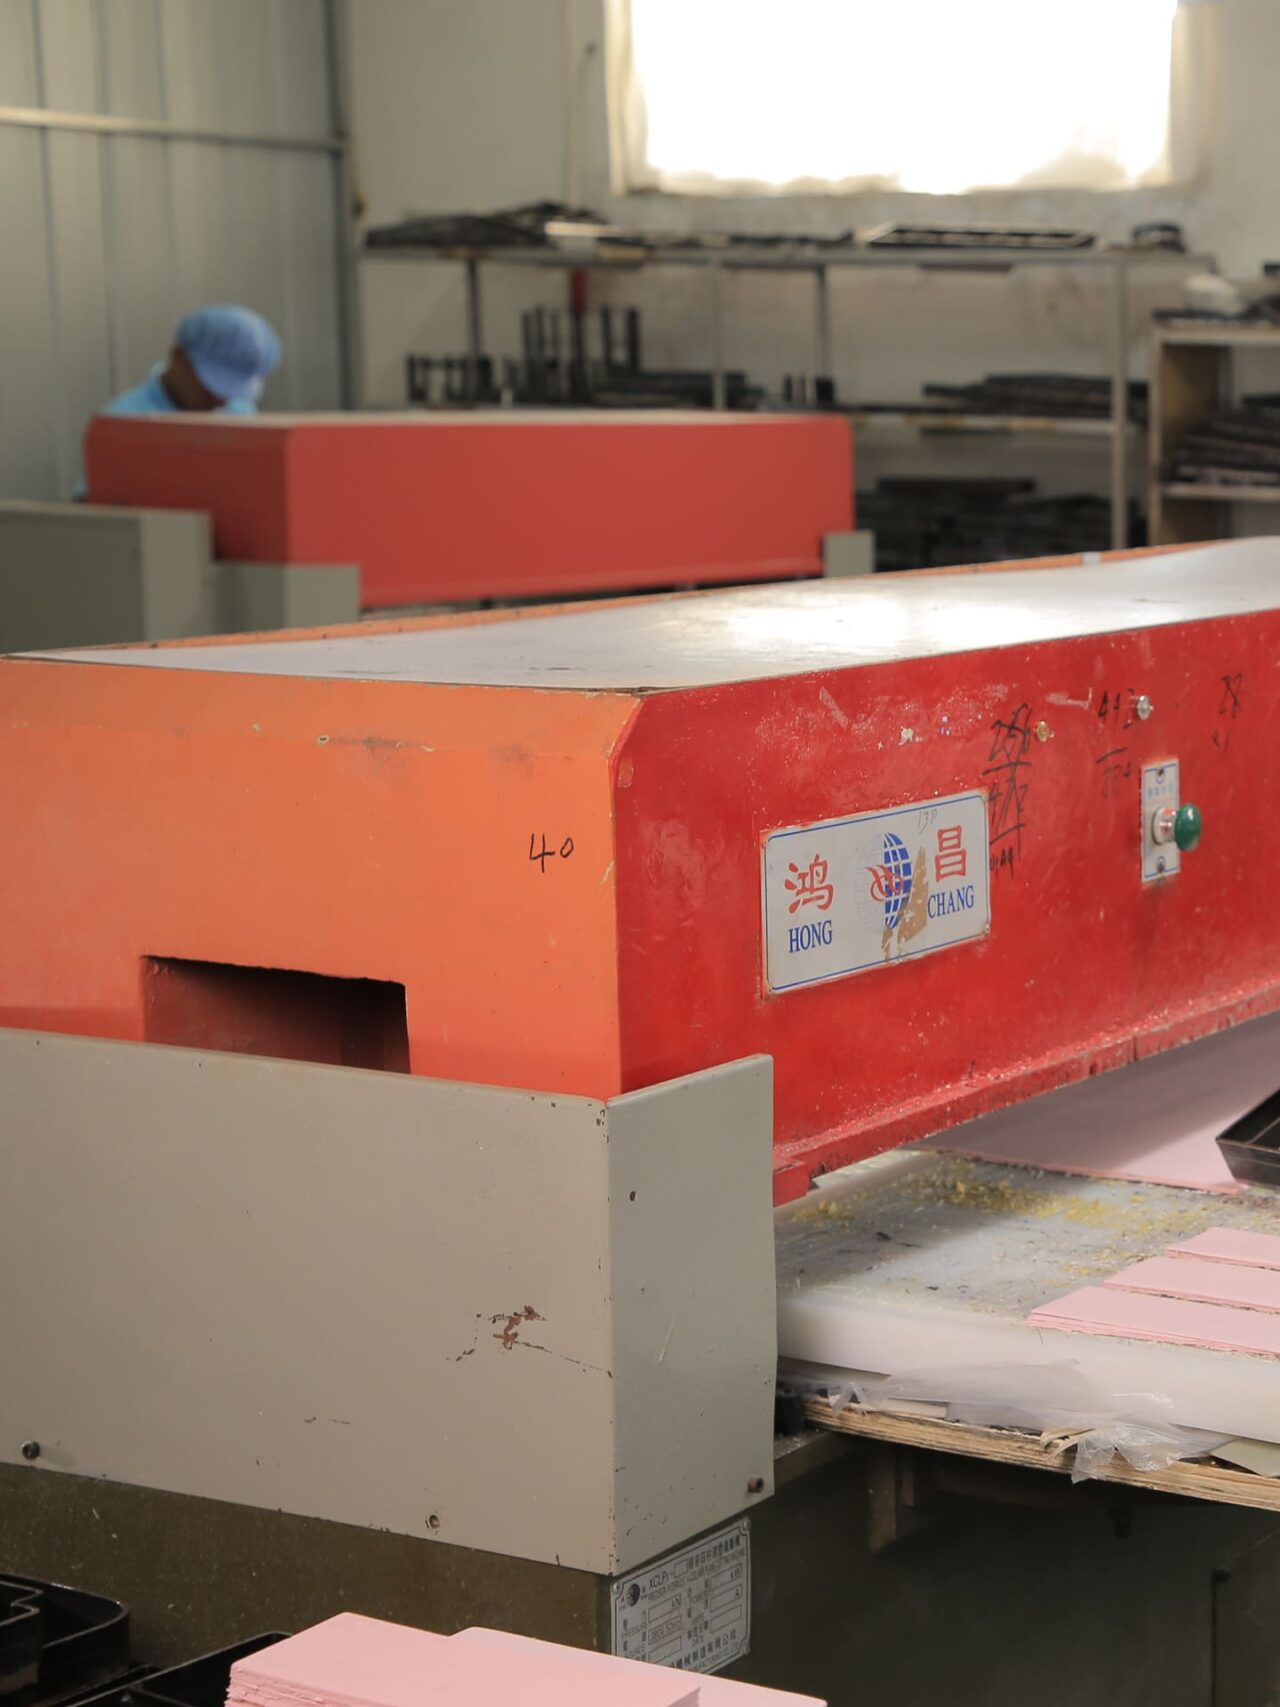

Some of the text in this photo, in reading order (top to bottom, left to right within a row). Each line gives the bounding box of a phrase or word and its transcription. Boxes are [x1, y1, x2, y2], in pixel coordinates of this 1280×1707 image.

[529, 833, 574, 873] 40
[784, 854, 833, 914] 鸿
[934, 825, 967, 882] 昌
[788, 885, 975, 954] HONG CHANG
